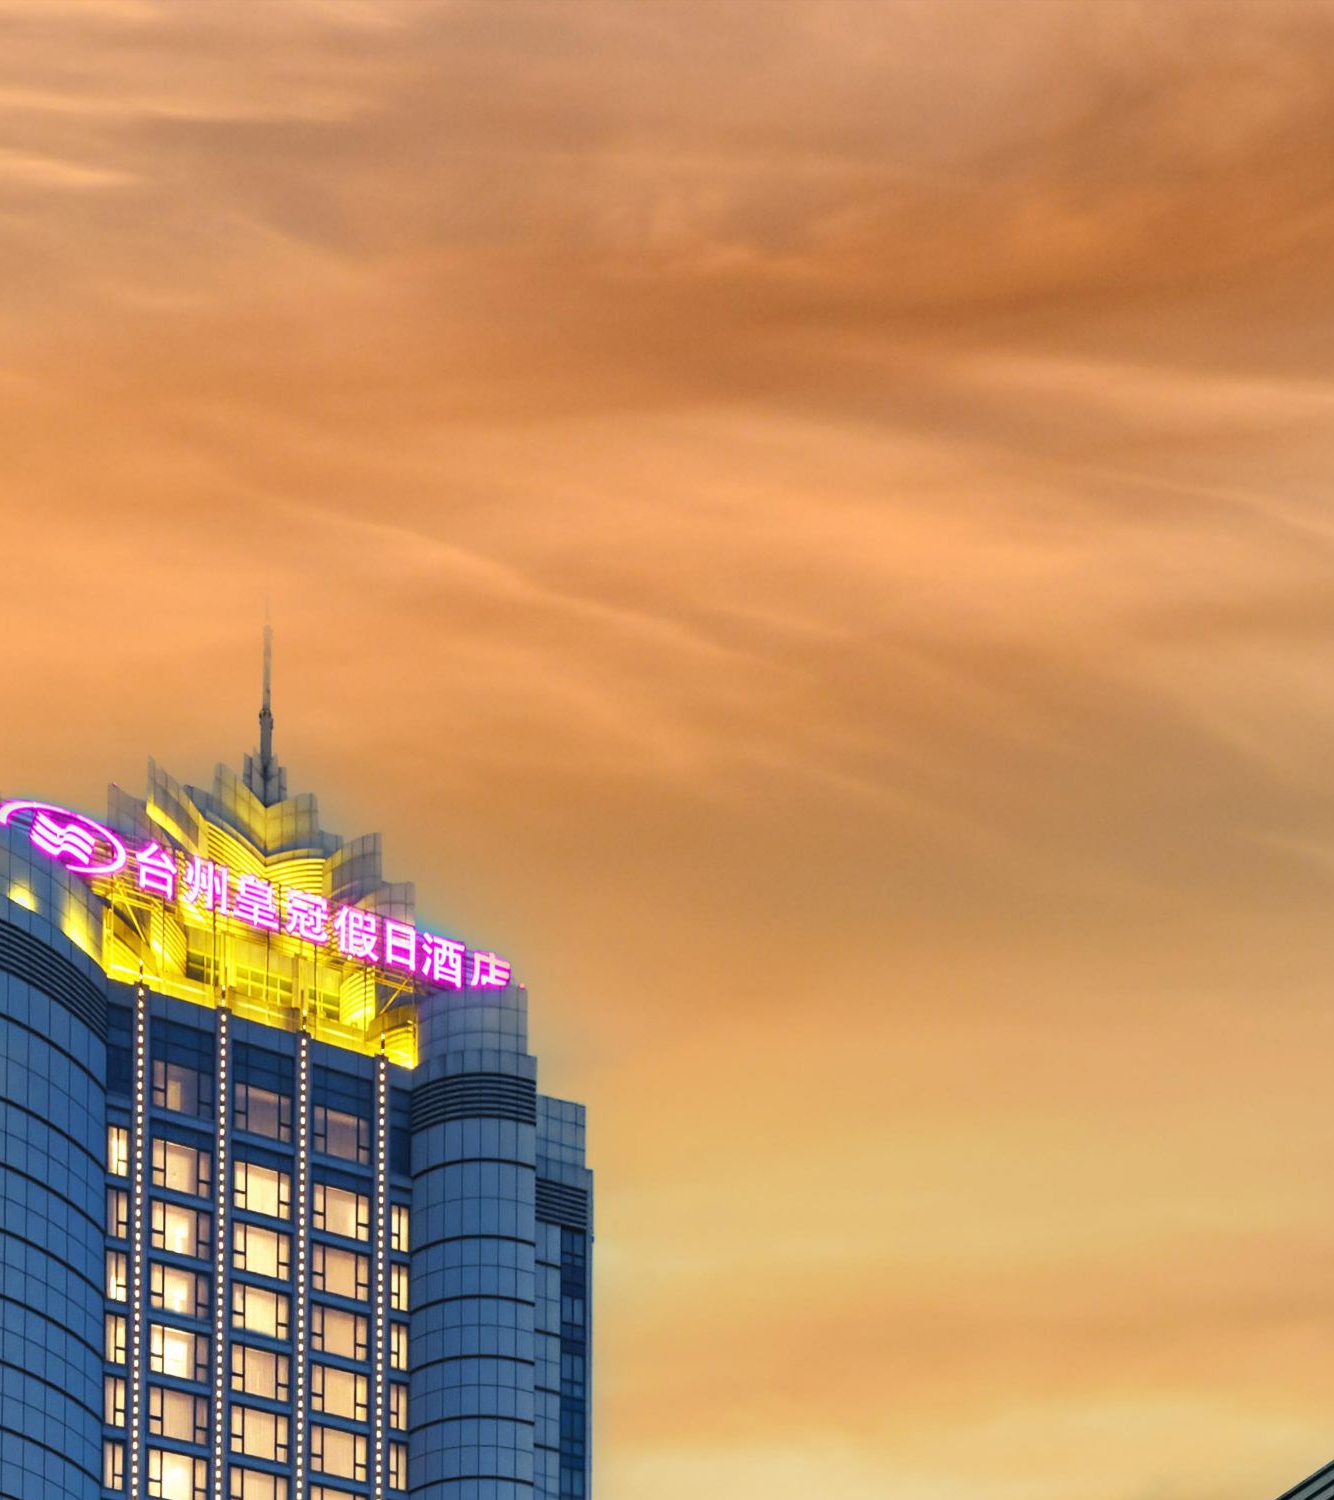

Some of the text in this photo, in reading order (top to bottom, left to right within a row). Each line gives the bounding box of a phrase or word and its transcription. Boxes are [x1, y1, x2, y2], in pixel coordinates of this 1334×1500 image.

[135, 844, 511, 989] 台州皇冠假日酒店
